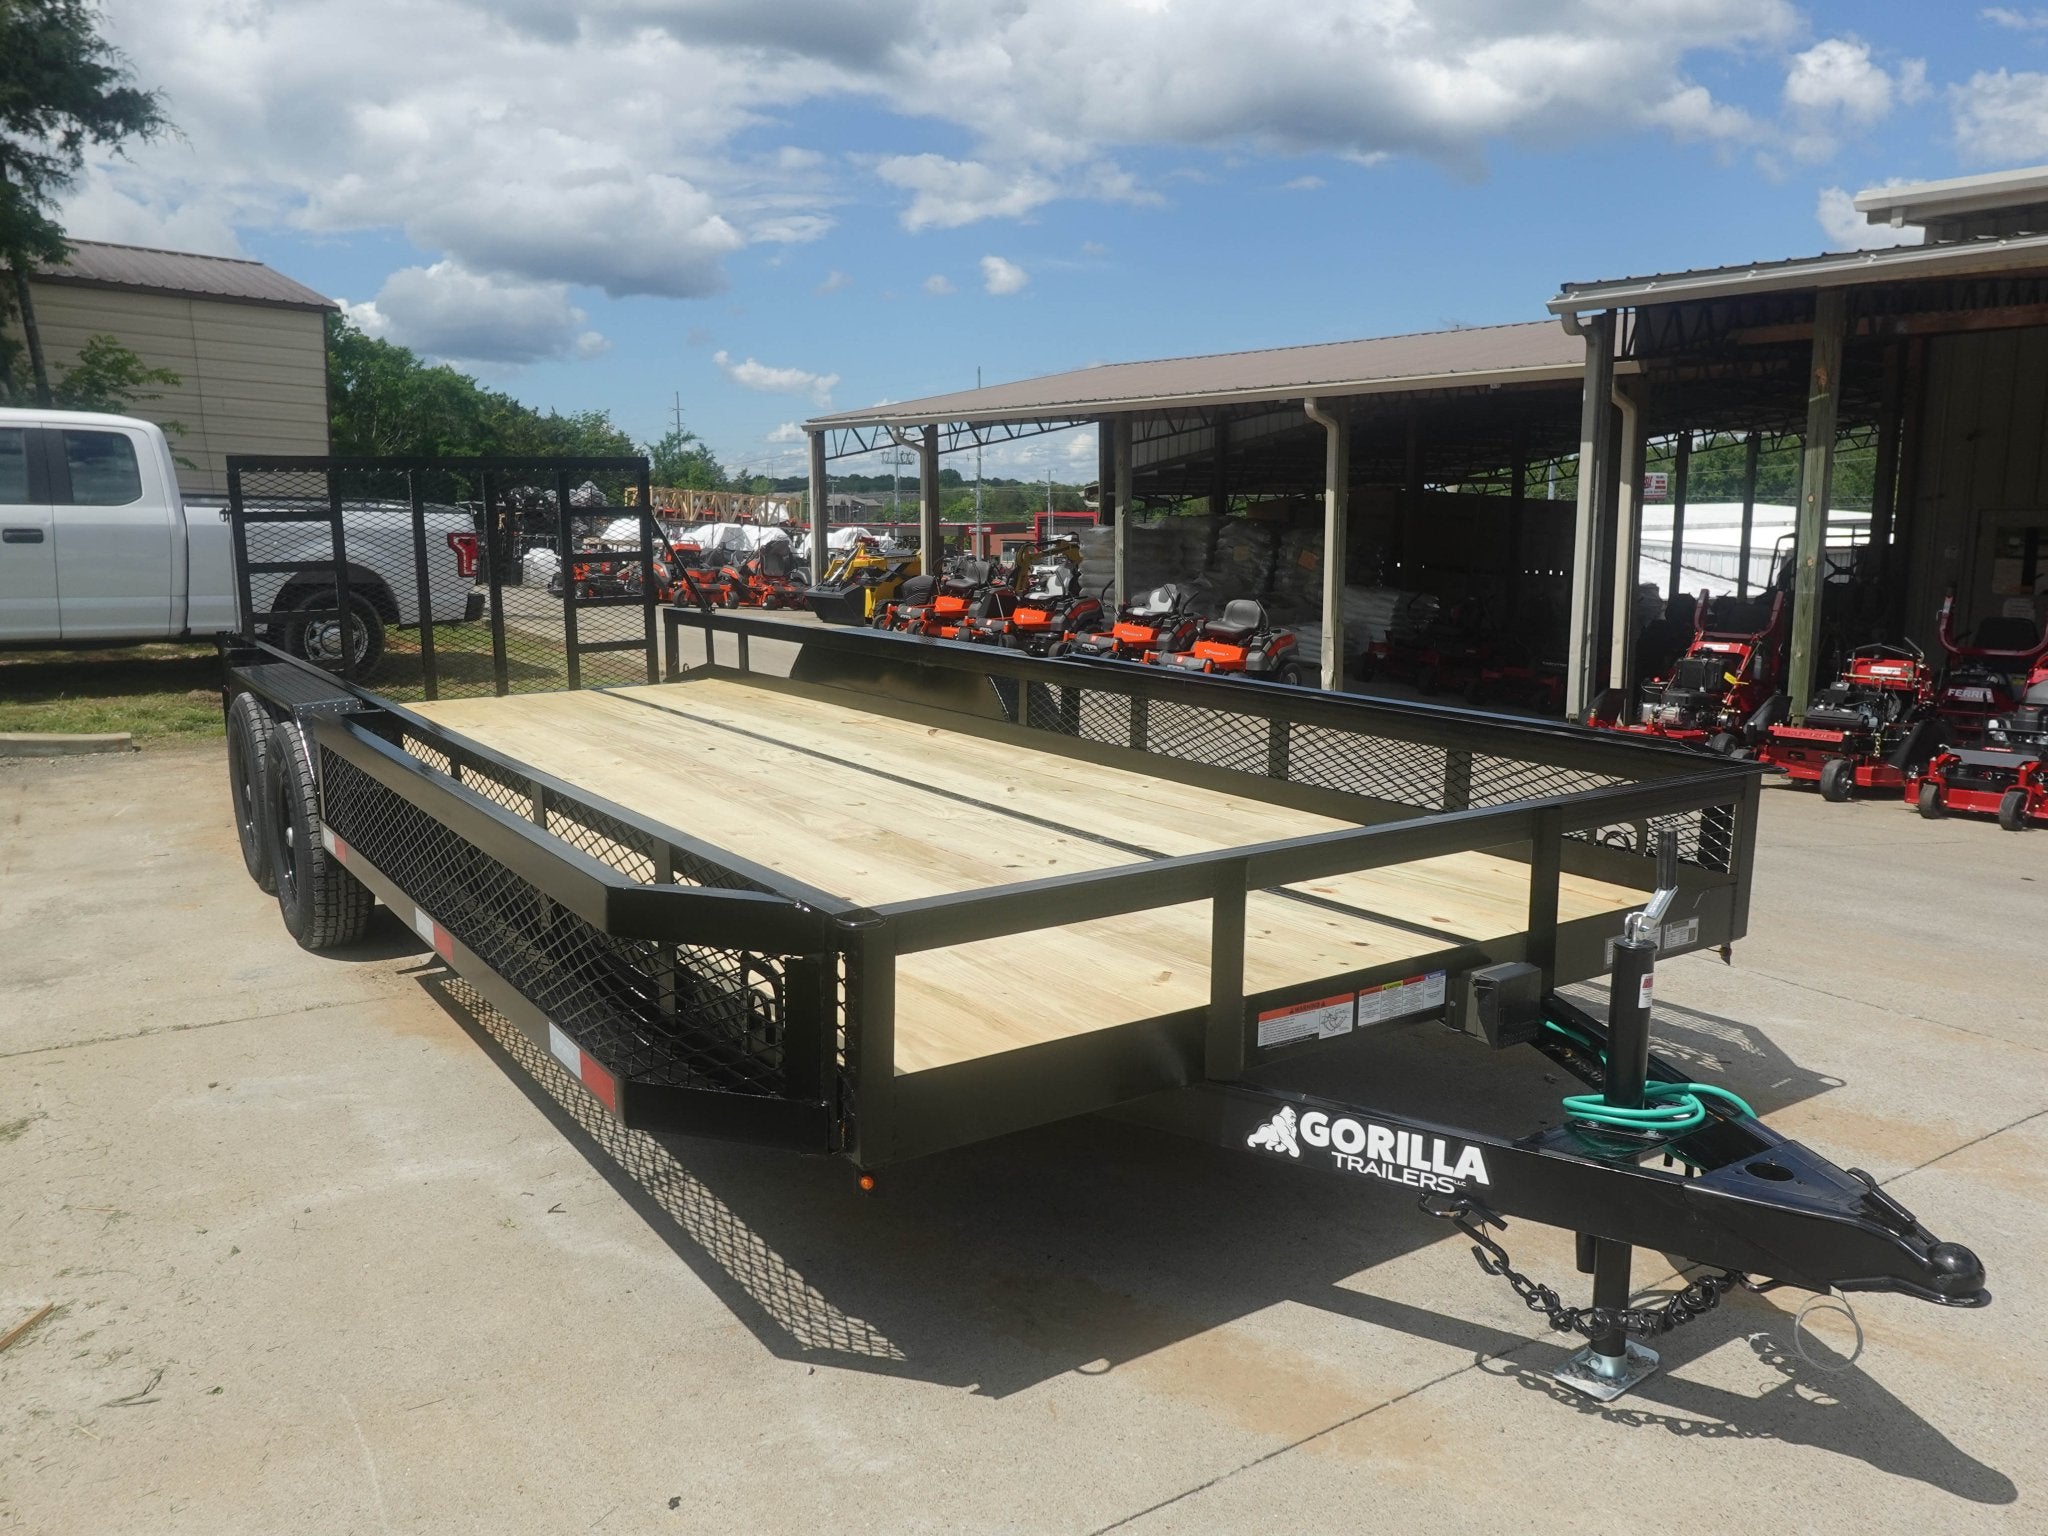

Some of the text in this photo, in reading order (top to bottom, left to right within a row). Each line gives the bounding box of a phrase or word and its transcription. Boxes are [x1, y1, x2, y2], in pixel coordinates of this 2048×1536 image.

[1947, 688, 1992, 699] FERRIS
[1299, 1111, 1490, 1186] GORILLA
[1331, 1151, 1455, 1194] TRAILERS
